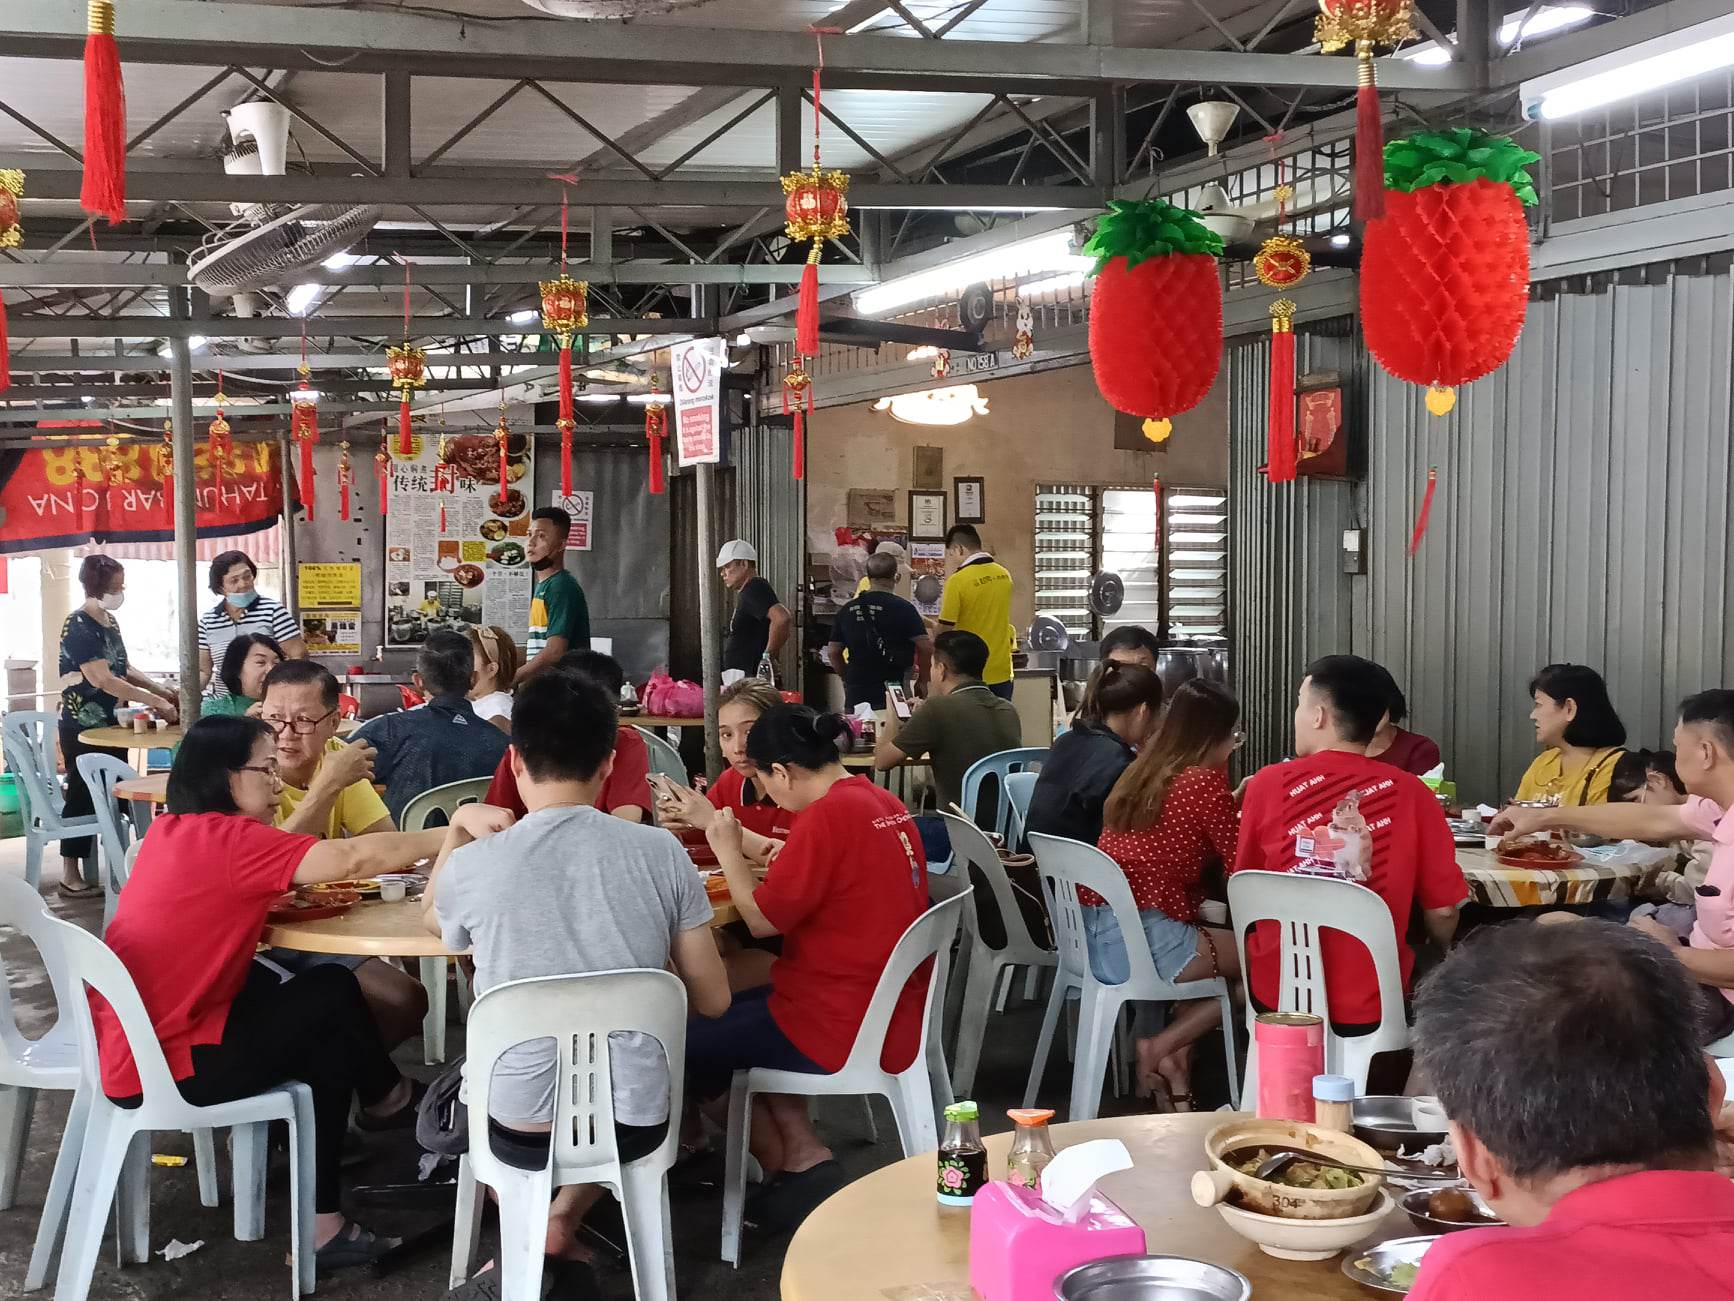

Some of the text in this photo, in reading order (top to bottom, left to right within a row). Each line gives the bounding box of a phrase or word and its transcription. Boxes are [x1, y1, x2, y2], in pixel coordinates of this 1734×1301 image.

[27, 488, 99, 517] CNA
[1289, 782, 1308, 797] HUAT
[1288, 820, 1307, 836] HUAT
